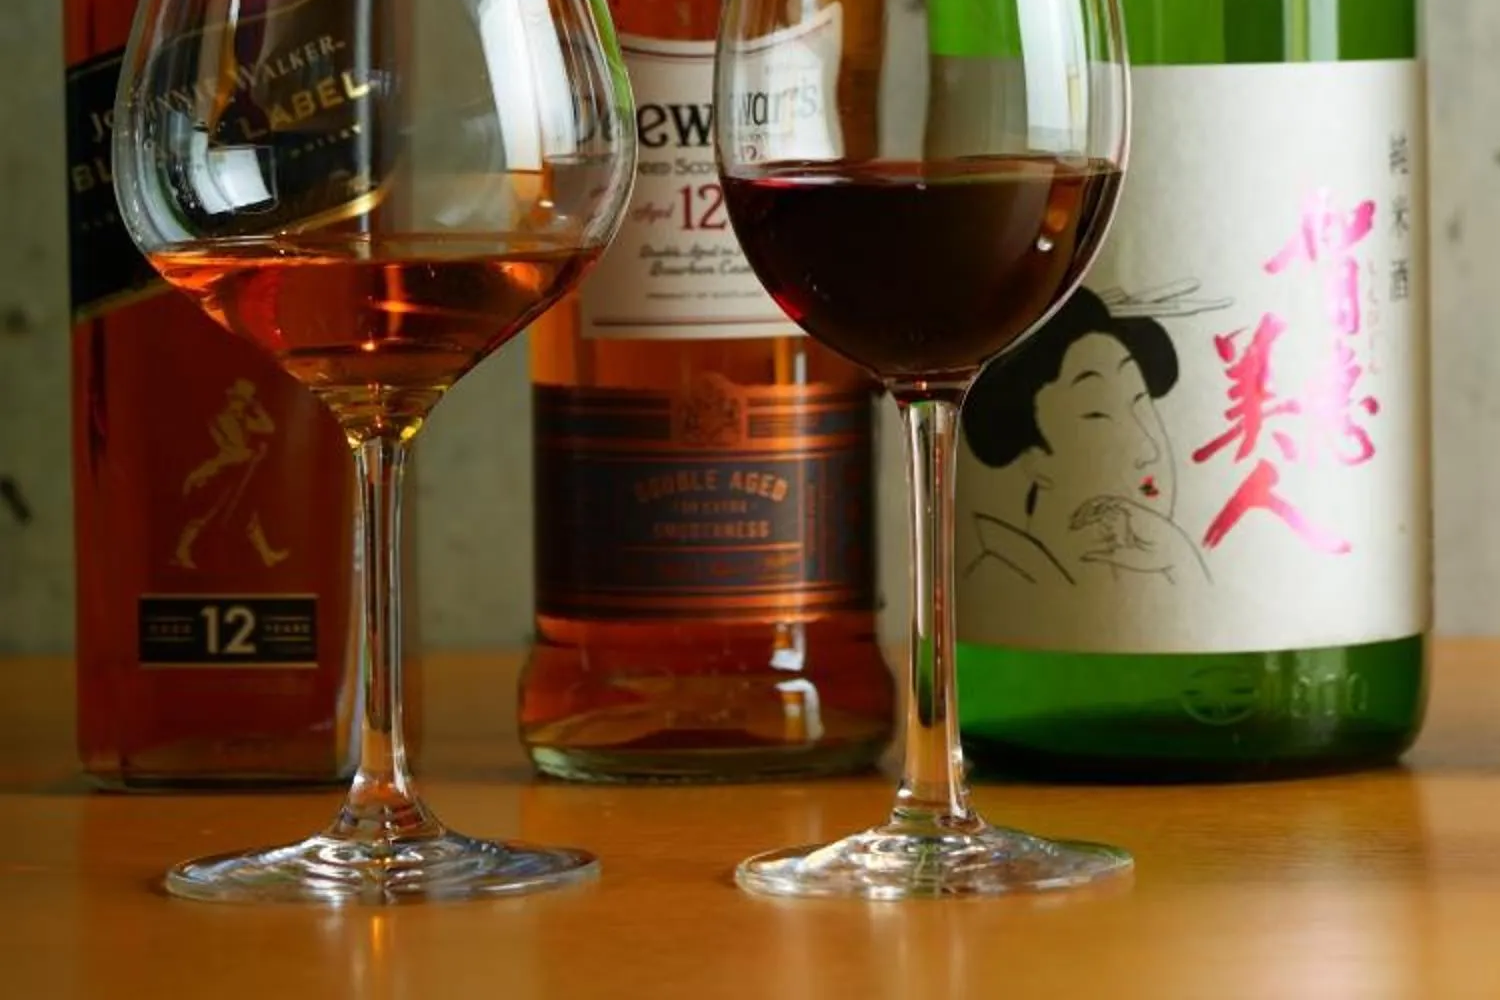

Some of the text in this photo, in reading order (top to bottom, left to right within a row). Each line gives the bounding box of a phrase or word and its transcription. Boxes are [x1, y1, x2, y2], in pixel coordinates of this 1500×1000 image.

[236, 70, 372, 141] LABEL
[679, 183, 727, 231] 12
[729, 471, 790, 503] AGED
[200, 604, 257, 654] 12
